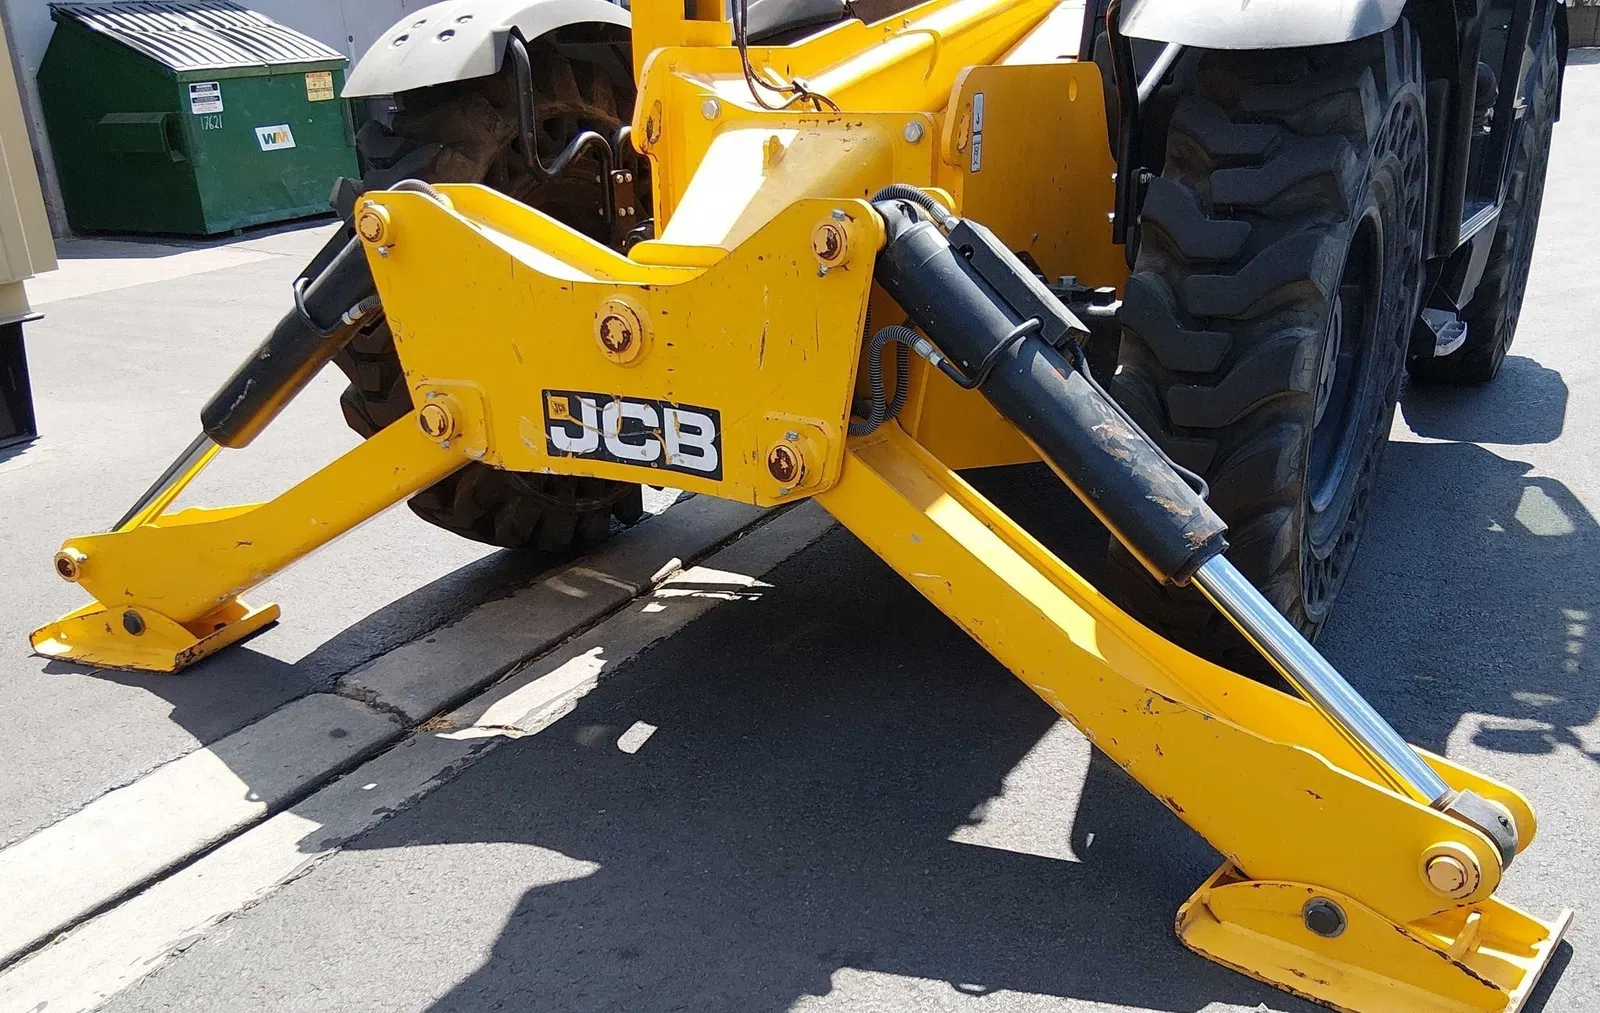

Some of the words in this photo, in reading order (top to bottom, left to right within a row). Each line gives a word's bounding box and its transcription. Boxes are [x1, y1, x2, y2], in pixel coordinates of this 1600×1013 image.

[200, 115, 223, 130] 17621
[261, 131, 290, 145] WM
[551, 399, 718, 472] JCB
